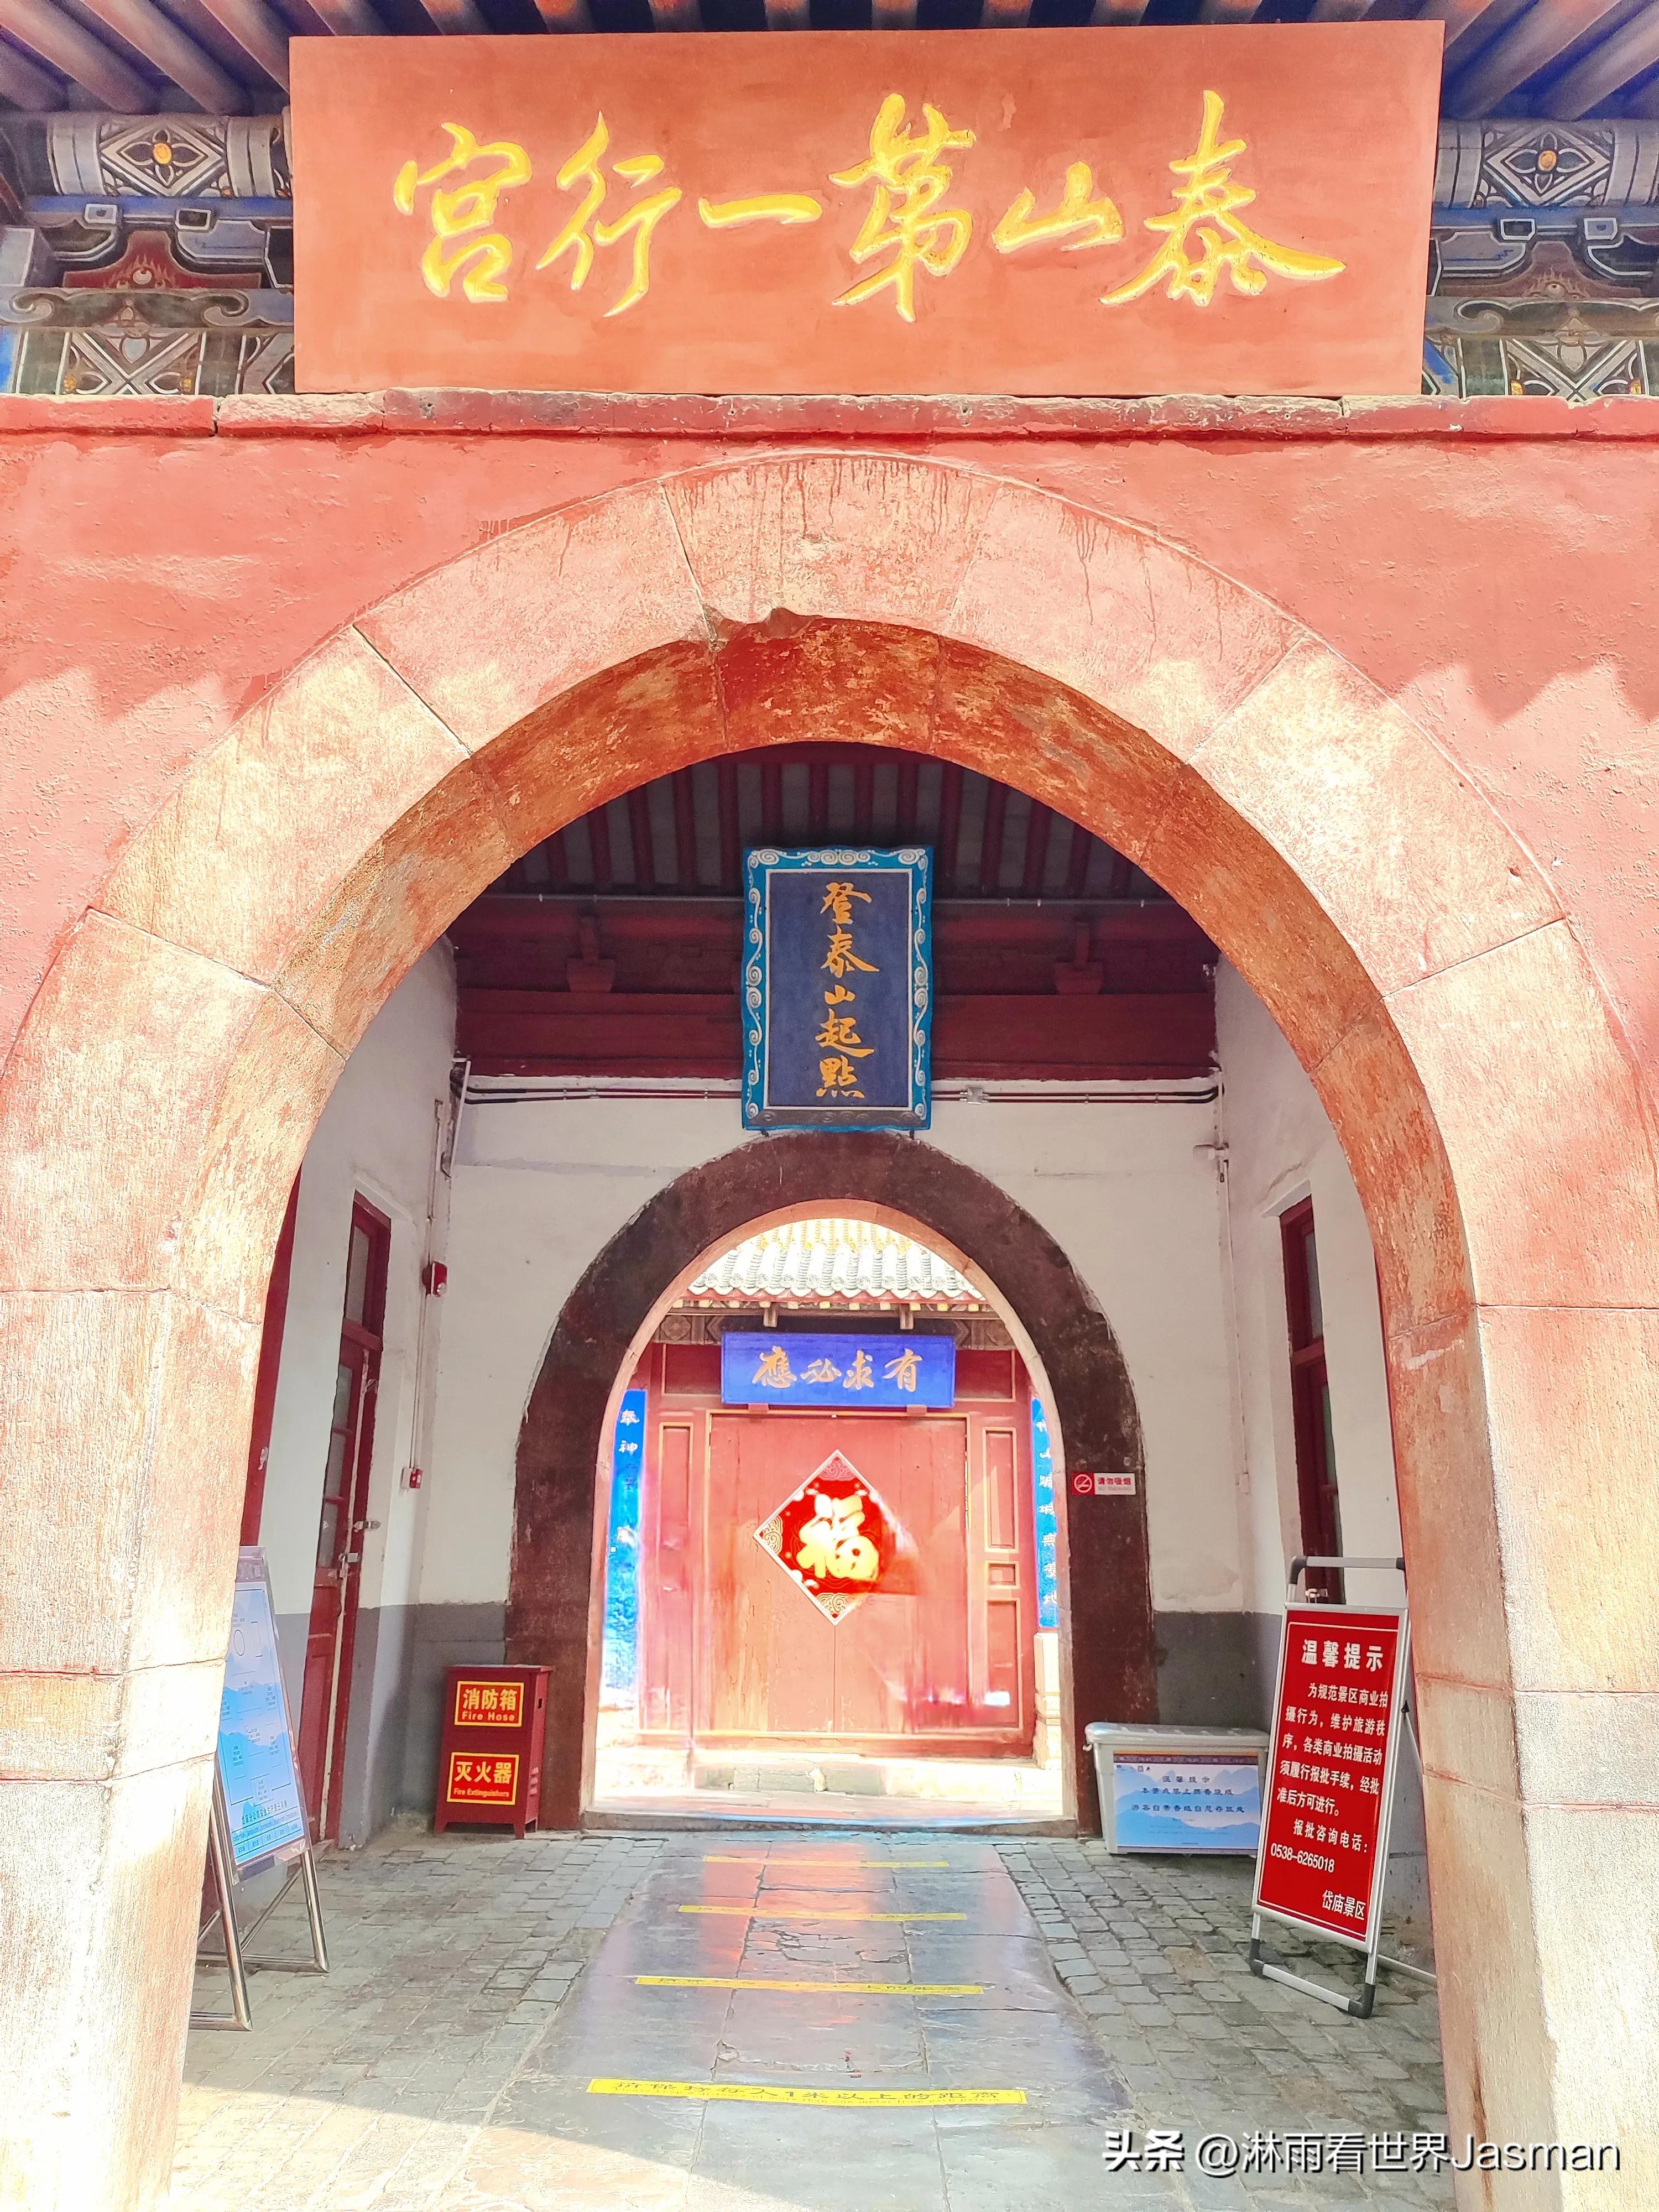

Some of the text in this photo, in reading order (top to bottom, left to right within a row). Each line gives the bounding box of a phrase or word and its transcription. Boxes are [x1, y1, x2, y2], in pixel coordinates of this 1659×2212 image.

[1097, 1477, 1131, 1485] 请勿吸烟
[796, 1493, 879, 1582] 福
[1301, 1639, 1384, 1672] 温馨提示
[462, 1688, 518, 1711] 消防箱
[1307, 1682, 1389, 1708] 为规范景区商业拍
[461, 1711, 515, 1721] Fire Hose
[454, 1761, 512, 1784] 灭火器
[453, 1787, 466, 1796] Fire
[1276, 1787, 1339, 1817] 准后方可进行。
[1271, 1843, 1335, 1873] 0538-6265018
[1322, 1889, 1366, 1921] 岱庙景区
